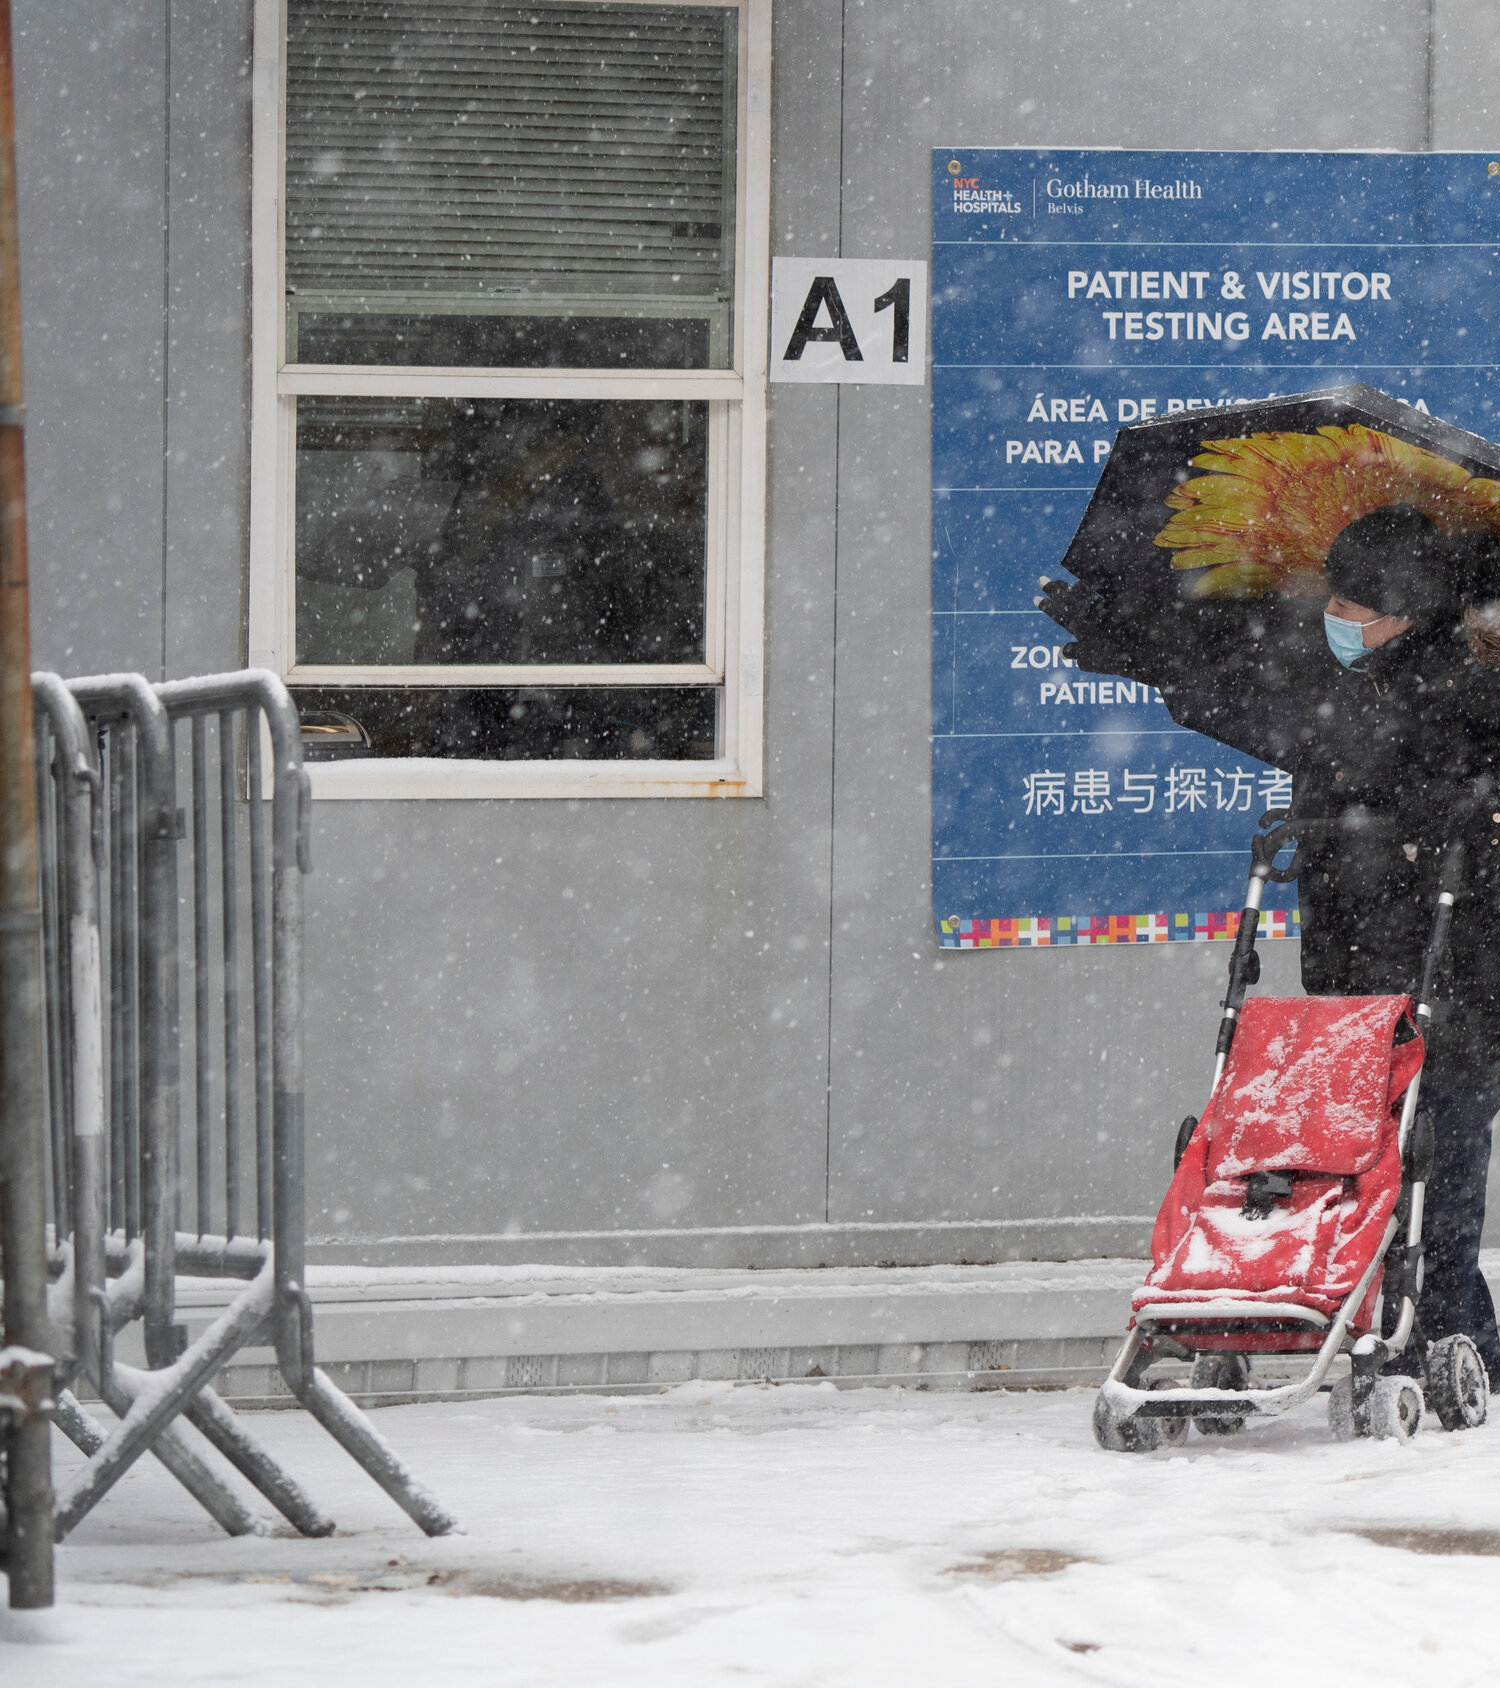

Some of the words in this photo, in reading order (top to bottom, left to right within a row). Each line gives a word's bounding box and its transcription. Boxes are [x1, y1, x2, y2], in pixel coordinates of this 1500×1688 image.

[953, 178, 980, 189] NYC
[1046, 178, 1130, 199] Gotham
[1134, 179, 1203, 200] Health
[953, 202, 1022, 213] HOSPITALS
[1047, 202, 1084, 214] Belvis
[1067, 271, 1211, 299] PATIENT
[1220, 271, 1246, 300] &
[1256, 271, 1392, 300] VISITOR
[782, 276, 911, 363] A1
[1102, 311, 1251, 341] TESTING
[1260, 312, 1357, 341] AREA
[1026, 392, 1109, 423] ÁREA
[1117, 398, 1157, 423] DE
[1005, 439, 1084, 464] PARA
[1010, 645, 1079, 669] ZON
[1022, 765, 1293, 817] 病患与探访者
